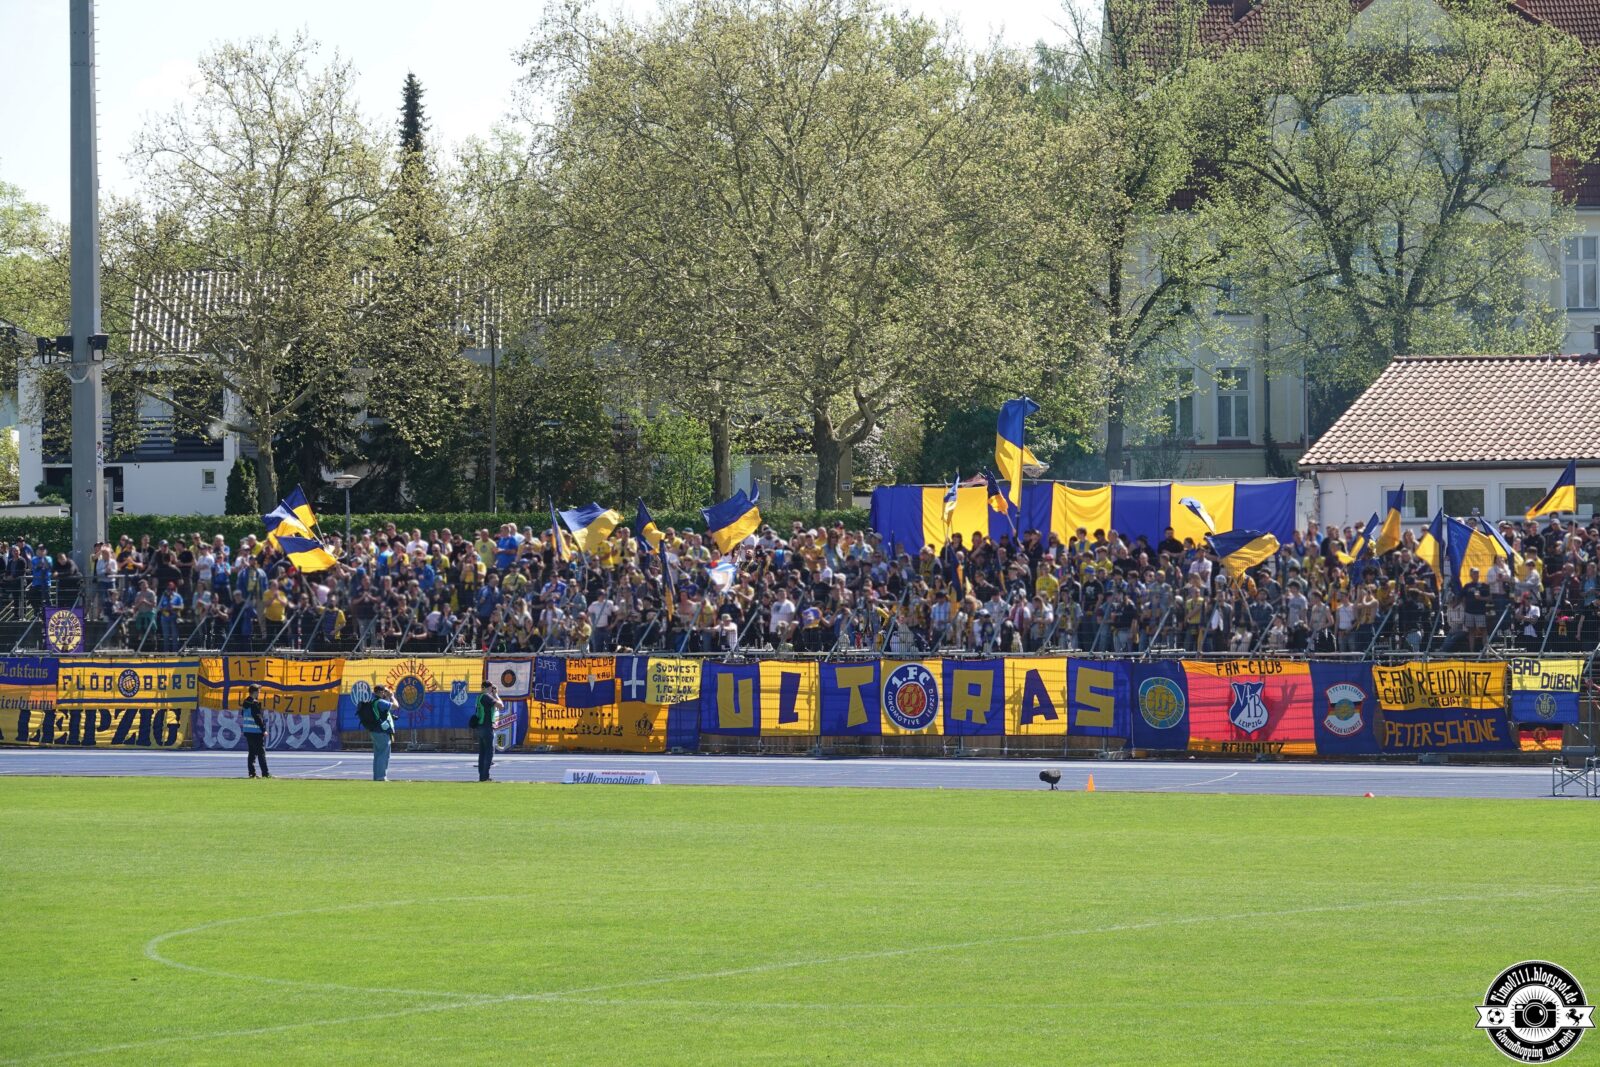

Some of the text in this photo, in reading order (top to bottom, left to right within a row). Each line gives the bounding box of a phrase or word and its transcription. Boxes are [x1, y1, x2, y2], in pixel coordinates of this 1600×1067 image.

[0, 662, 48, 678] Lokfans
[537, 658, 557, 671] SUPER
[568, 657, 614, 669] FAN-CLUB
[1216, 660, 1283, 676] FAN-CLUB
[1513, 658, 1541, 677] BAD
[299, 664, 336, 682] LOK
[891, 666, 930, 688] 1.FC
[1377, 668, 1414, 687] FAN
[1540, 671, 1580, 691] DÜBEN
[677, 685, 692, 694] LOK
[1383, 668, 1492, 705] CLUB REUDNITZ
[237, 690, 320, 713] LIPZIG
[717, 666, 1115, 729] ULTRAS
[1234, 684, 1264, 718] VfB
[887, 691, 920, 725] LOKOMOTIVE
[1238, 719, 1263, 729] LEIPZIG
[1384, 720, 1433, 748] PETER
